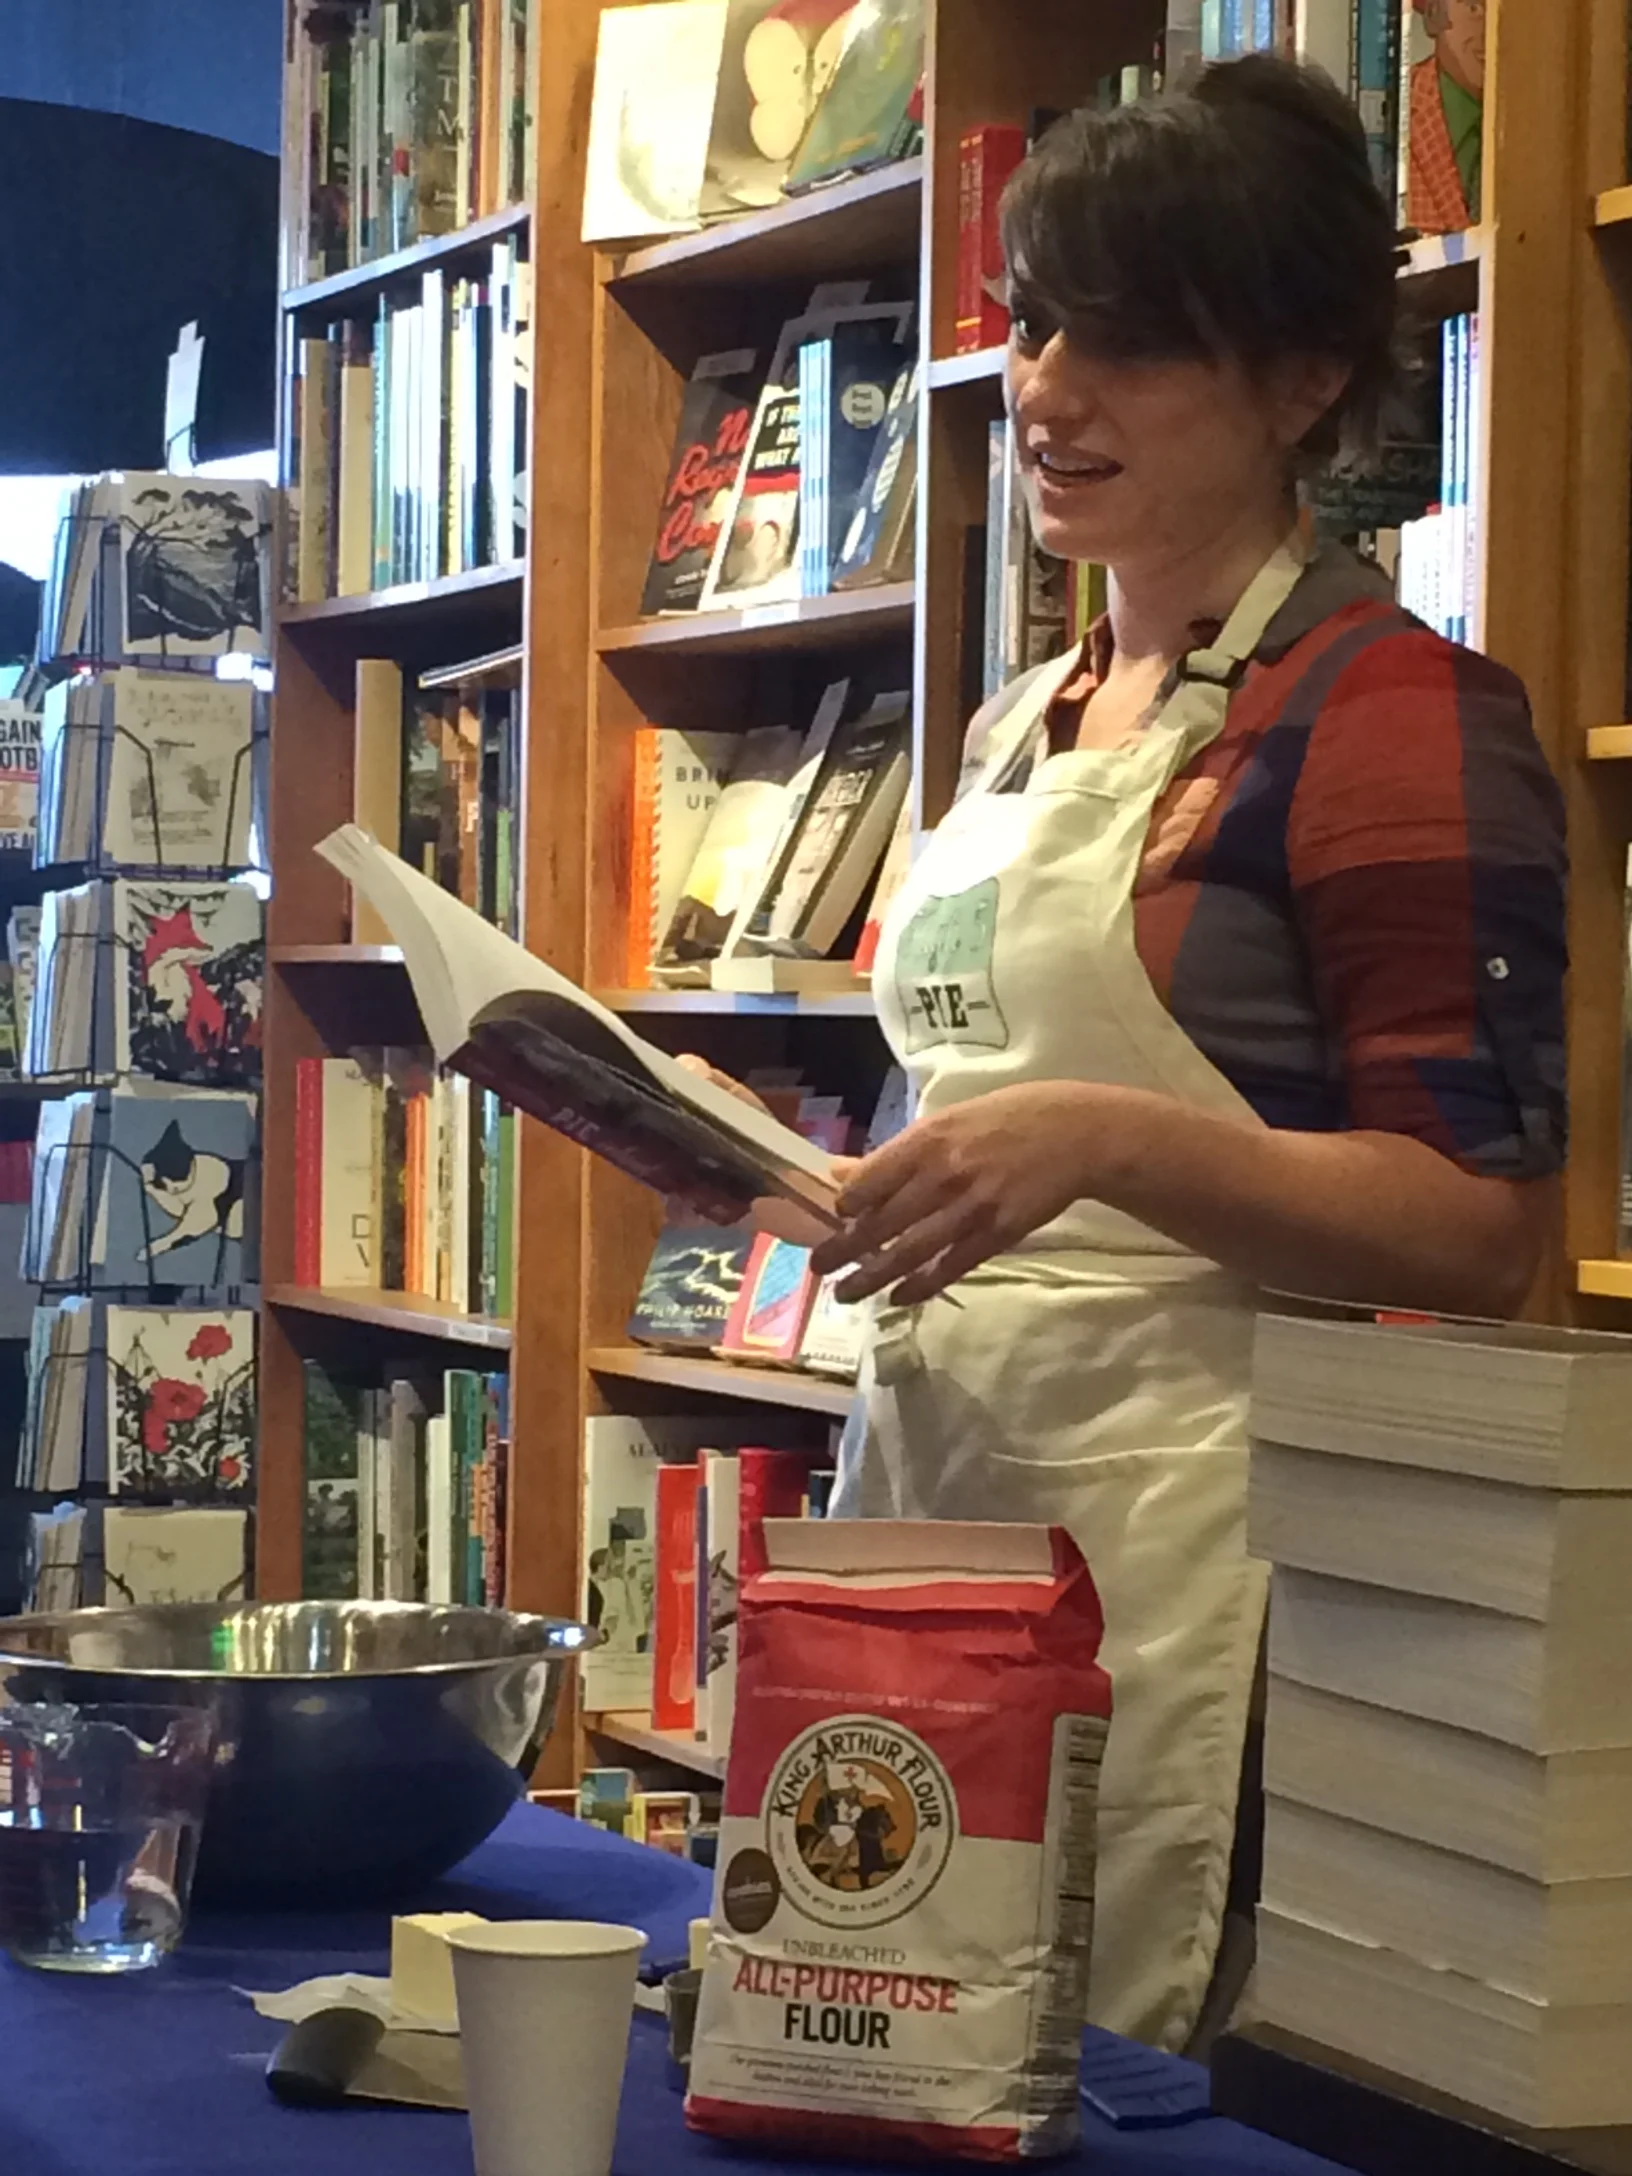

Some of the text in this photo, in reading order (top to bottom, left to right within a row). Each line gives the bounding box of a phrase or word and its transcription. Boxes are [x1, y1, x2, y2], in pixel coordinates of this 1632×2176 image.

[915, 983, 969, 1029] PIE
[771, 1731, 942, 1833] KING ARTHUR FLOUR
[782, 1938, 907, 1966] UNBLEACHED
[732, 1953, 960, 2015] ALL-PURPOSE
[784, 2002, 891, 2049] FLOUR
